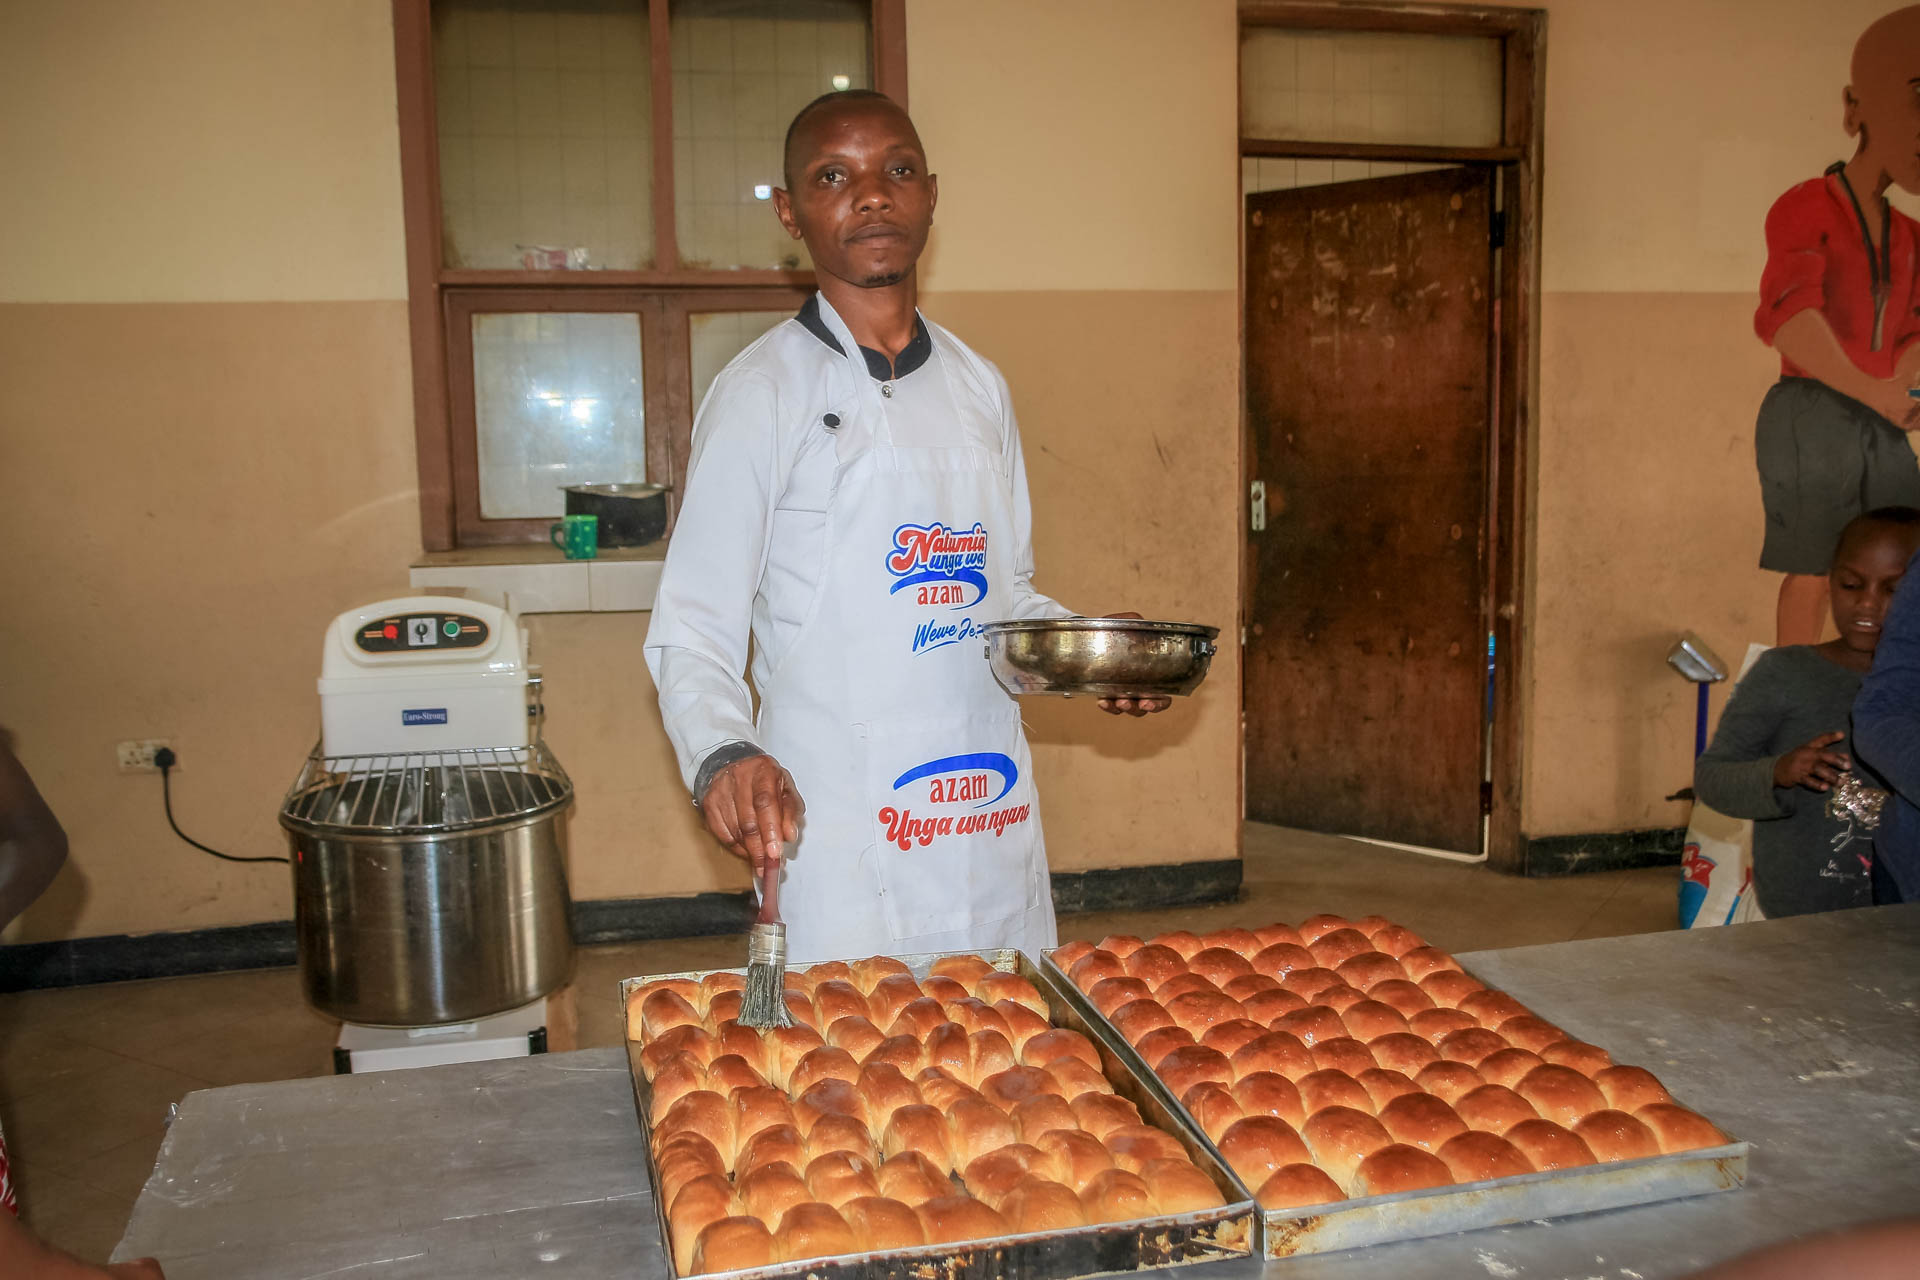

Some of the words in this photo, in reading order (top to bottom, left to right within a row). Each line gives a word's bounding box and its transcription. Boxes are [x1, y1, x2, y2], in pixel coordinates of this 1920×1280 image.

[891, 527, 986, 572] Natumia
[929, 552, 964, 575] unga
[965, 552, 984, 566] wa
[917, 584, 964, 606] azam
[912, 619, 958, 652] Wewe
[929, 774, 989, 804] azam
[878, 806, 954, 852] Unga
[955, 813, 988, 836] wa
[987, 802, 1030, 838] ngano
